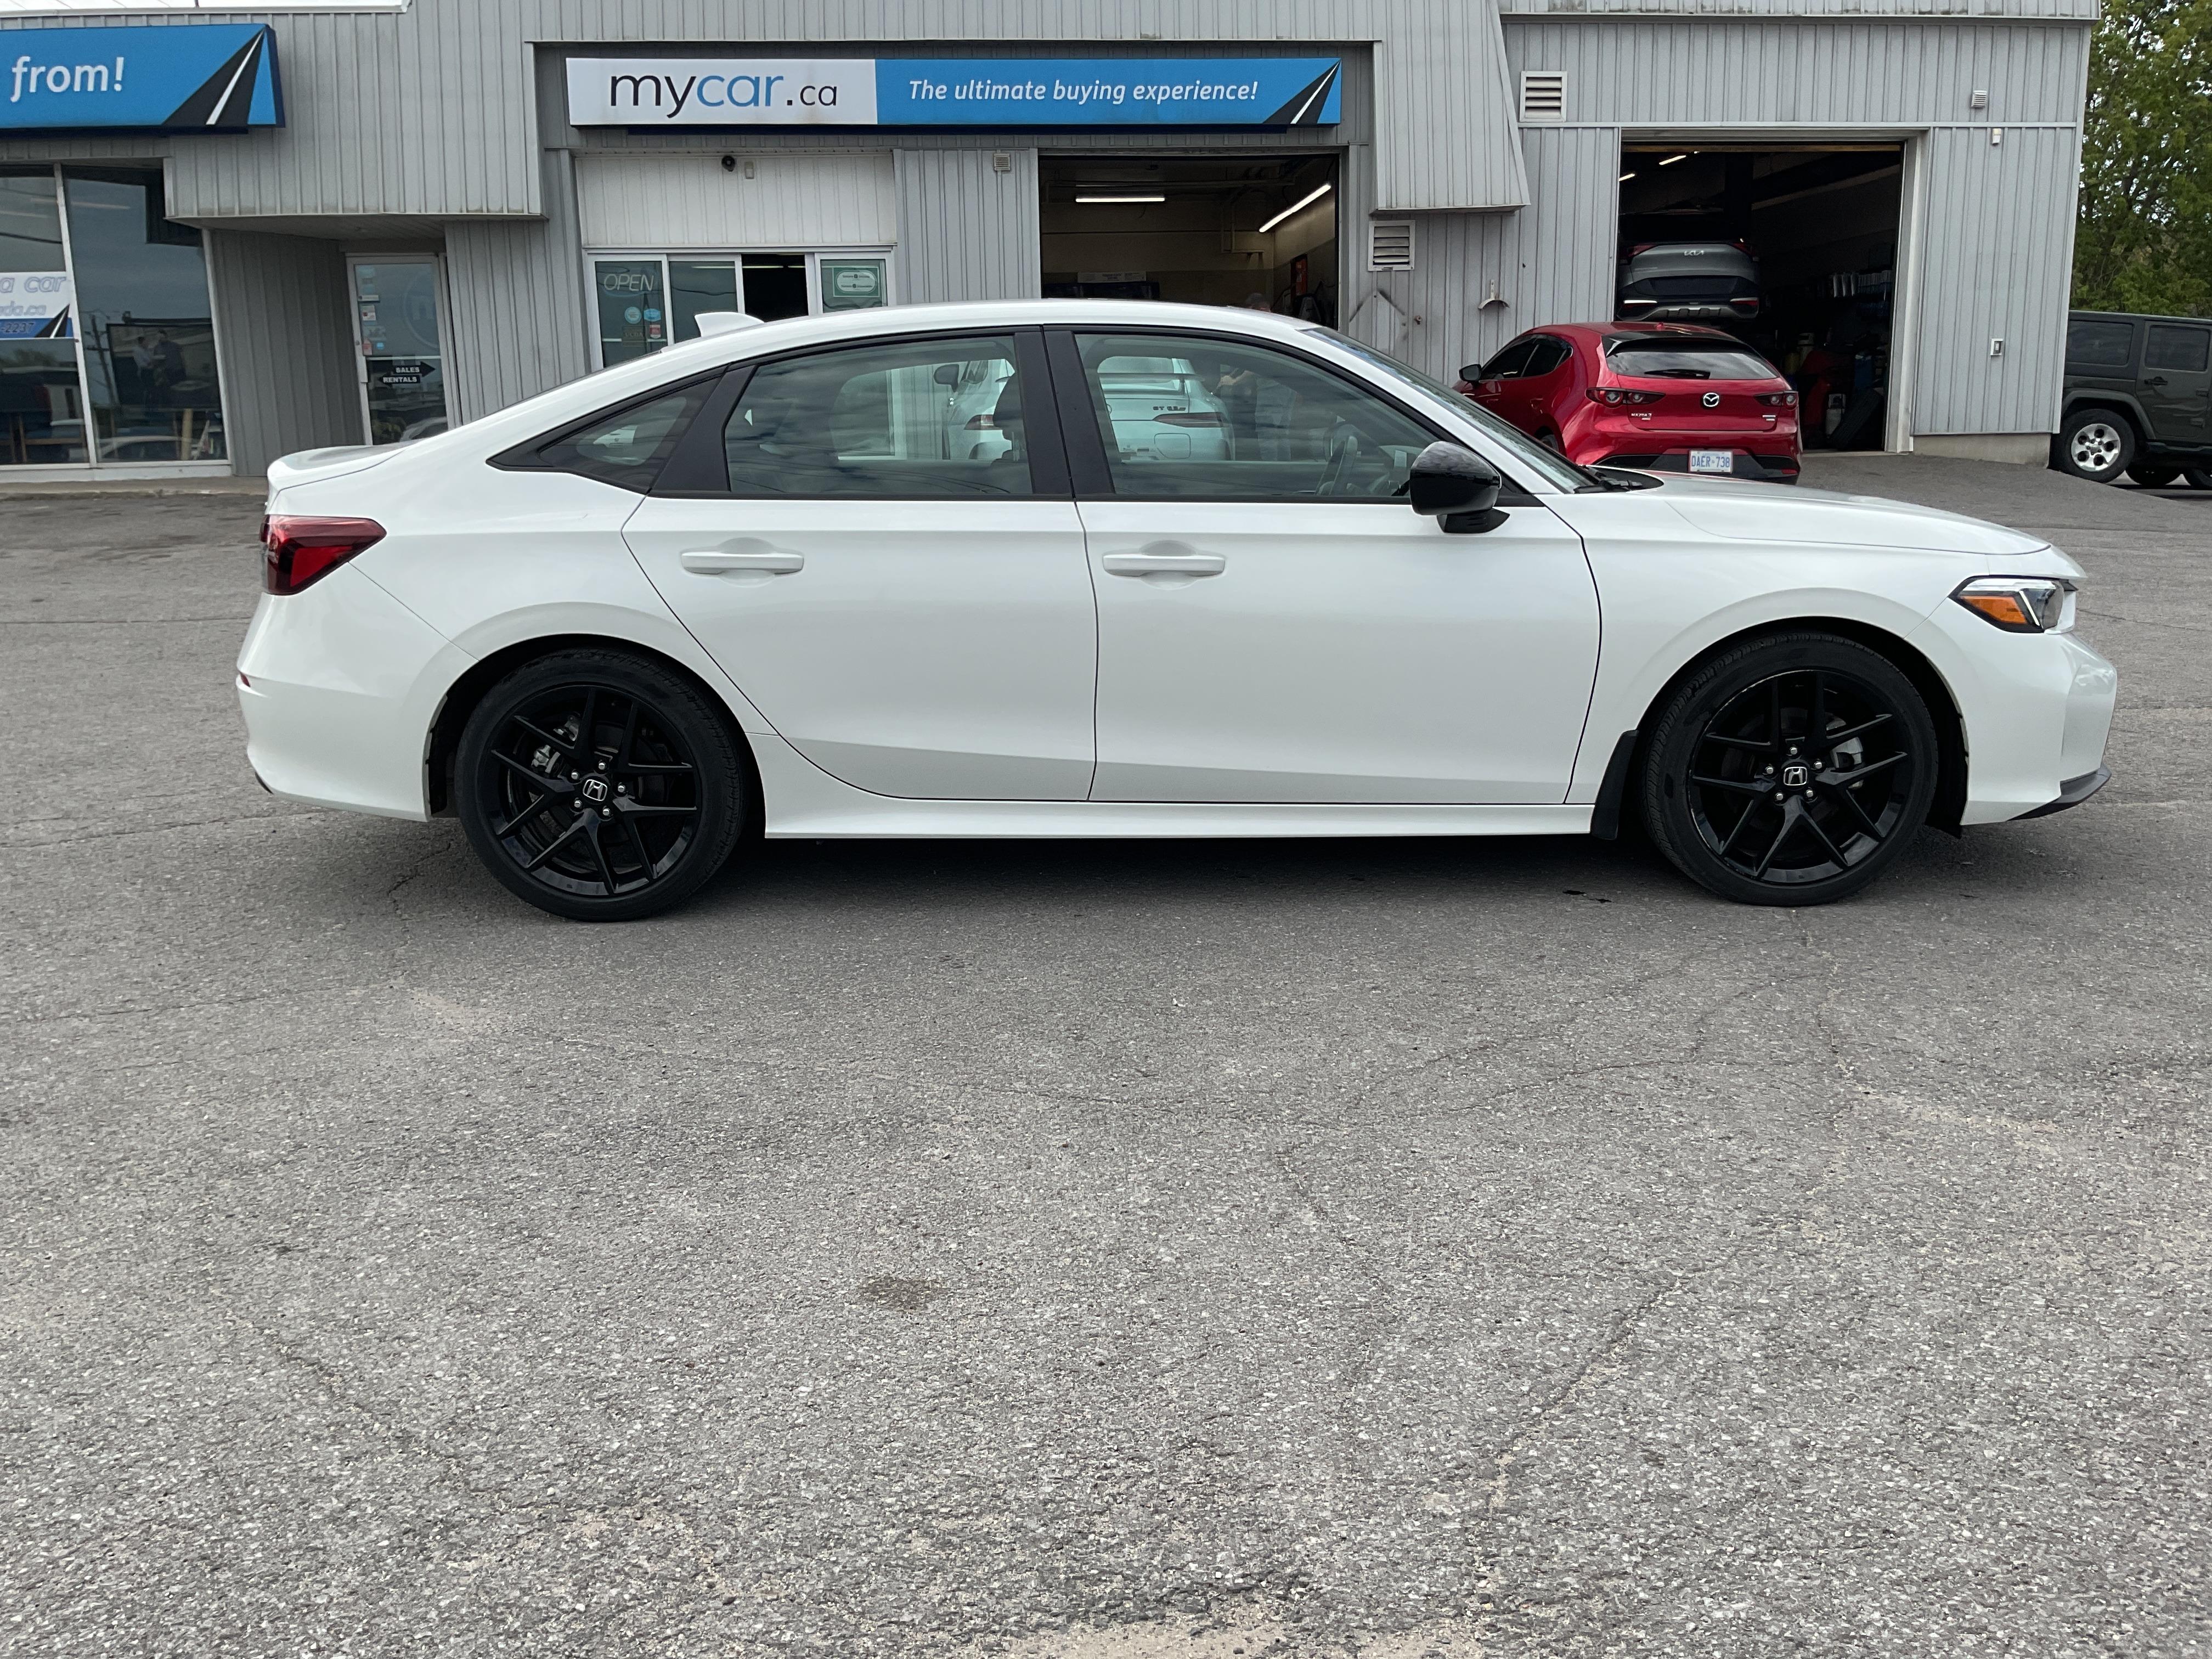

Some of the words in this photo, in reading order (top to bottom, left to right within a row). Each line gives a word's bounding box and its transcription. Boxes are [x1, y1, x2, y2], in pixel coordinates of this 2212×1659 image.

[10, 56, 125, 103] from!
[910, 80, 947, 100] The
[955, 80, 1046, 100] ultimate
[1053, 79, 1126, 105] buying
[1133, 80, 1258, 105] experience!
[611, 75, 838, 119] mycar.ca
[24, 276, 67, 293] car
[604, 274, 654, 291] OPEN
